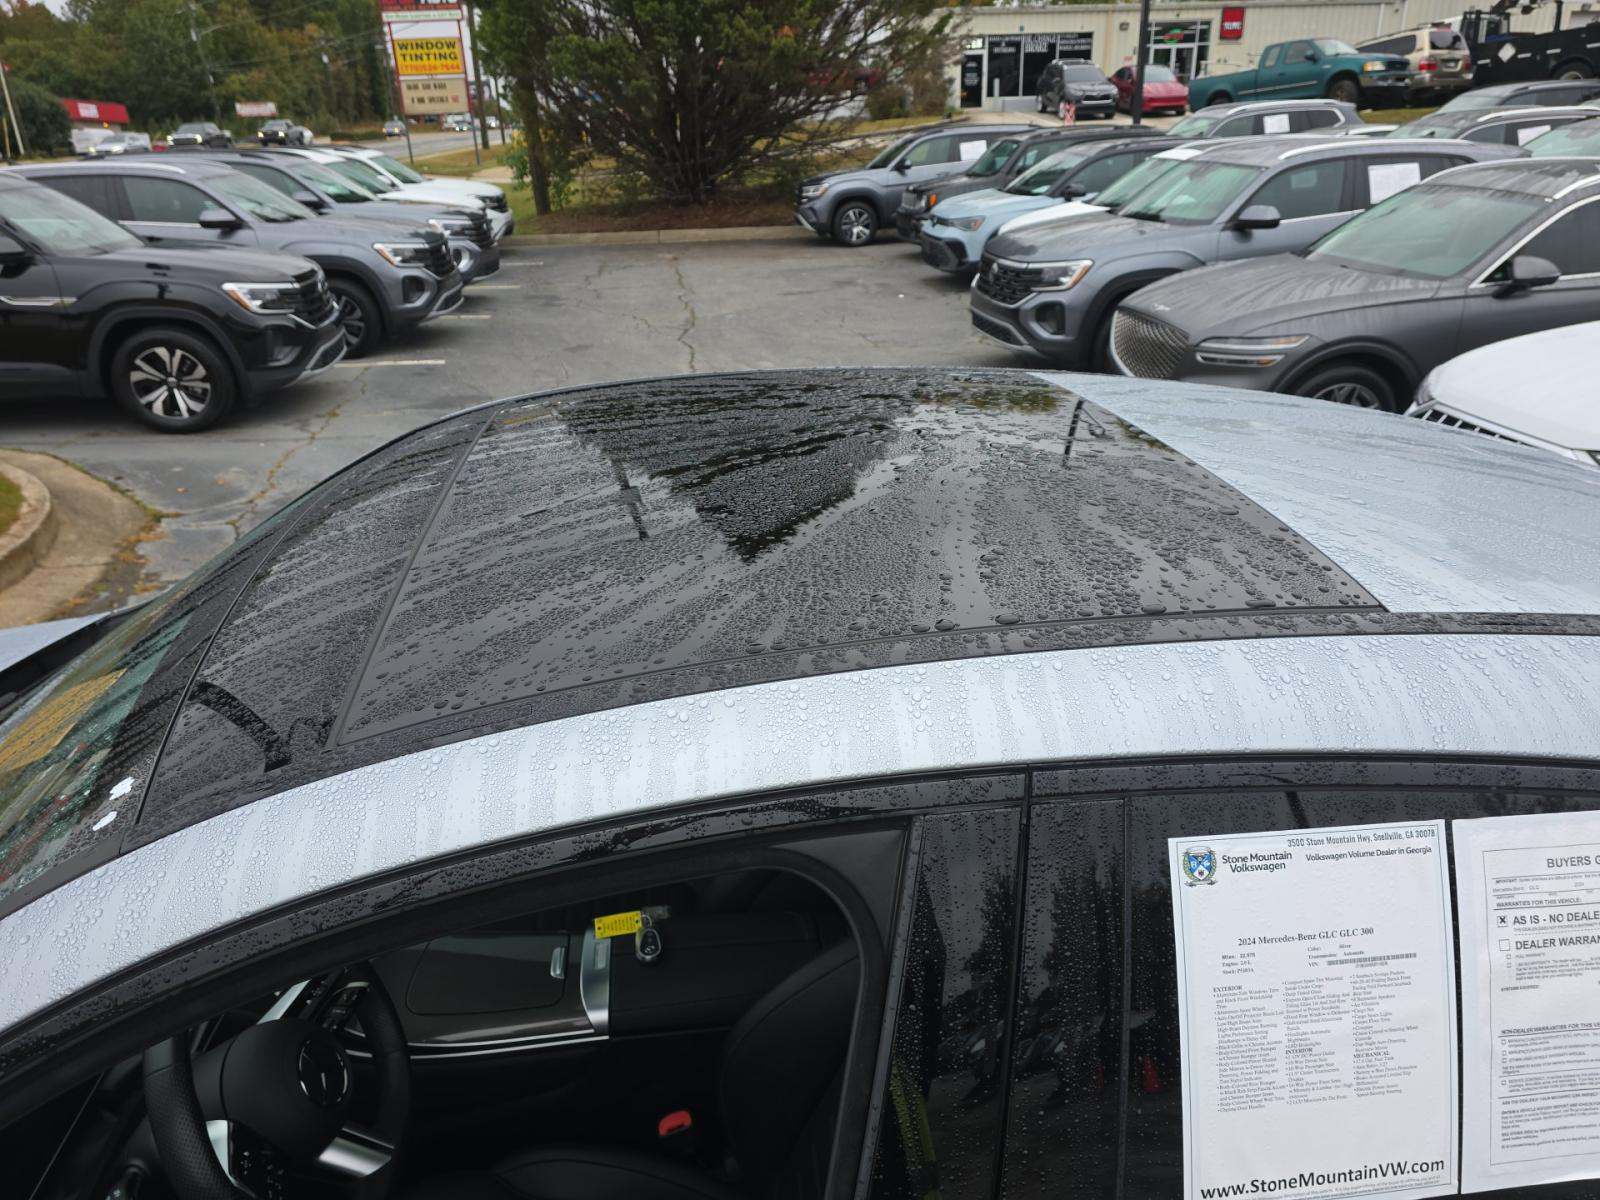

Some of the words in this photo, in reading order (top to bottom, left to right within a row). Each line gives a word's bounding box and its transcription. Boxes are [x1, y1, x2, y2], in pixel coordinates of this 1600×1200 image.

[398, 41, 456, 50] WINDOW
[401, 51, 458, 62] TINTING
[1288, 838, 1304, 847] 3500
[1306, 836, 1324, 846] Stone
[1326, 834, 1356, 844] Mountain
[1222, 854, 1248, 864] Stone
[1249, 851, 1292, 862] Mountain
[1306, 852, 1347, 862] Volkswagen
[1348, 850, 1376, 858] Volume
[1376, 848, 1397, 857] Dealer
[1405, 845, 1432, 855] Georgia
[1230, 862, 1286, 873] Volkswagen
[1546, 856, 1592, 868] BUYERS
[1513, 916, 1527, 925] AS
[1530, 915, 1540, 924] IS
[1549, 913, 1564, 923] NO
[1238, 938, 1256, 946] 2024
[1258, 932, 1317, 945] Mercedes-Benz
[1318, 930, 1338, 940] GLC
[1340, 928, 1358, 938] GLC
[1516, 938, 1556, 950] DEALER
[1200, 1160, 1445, 1200] www.StoneMountainVW.com
